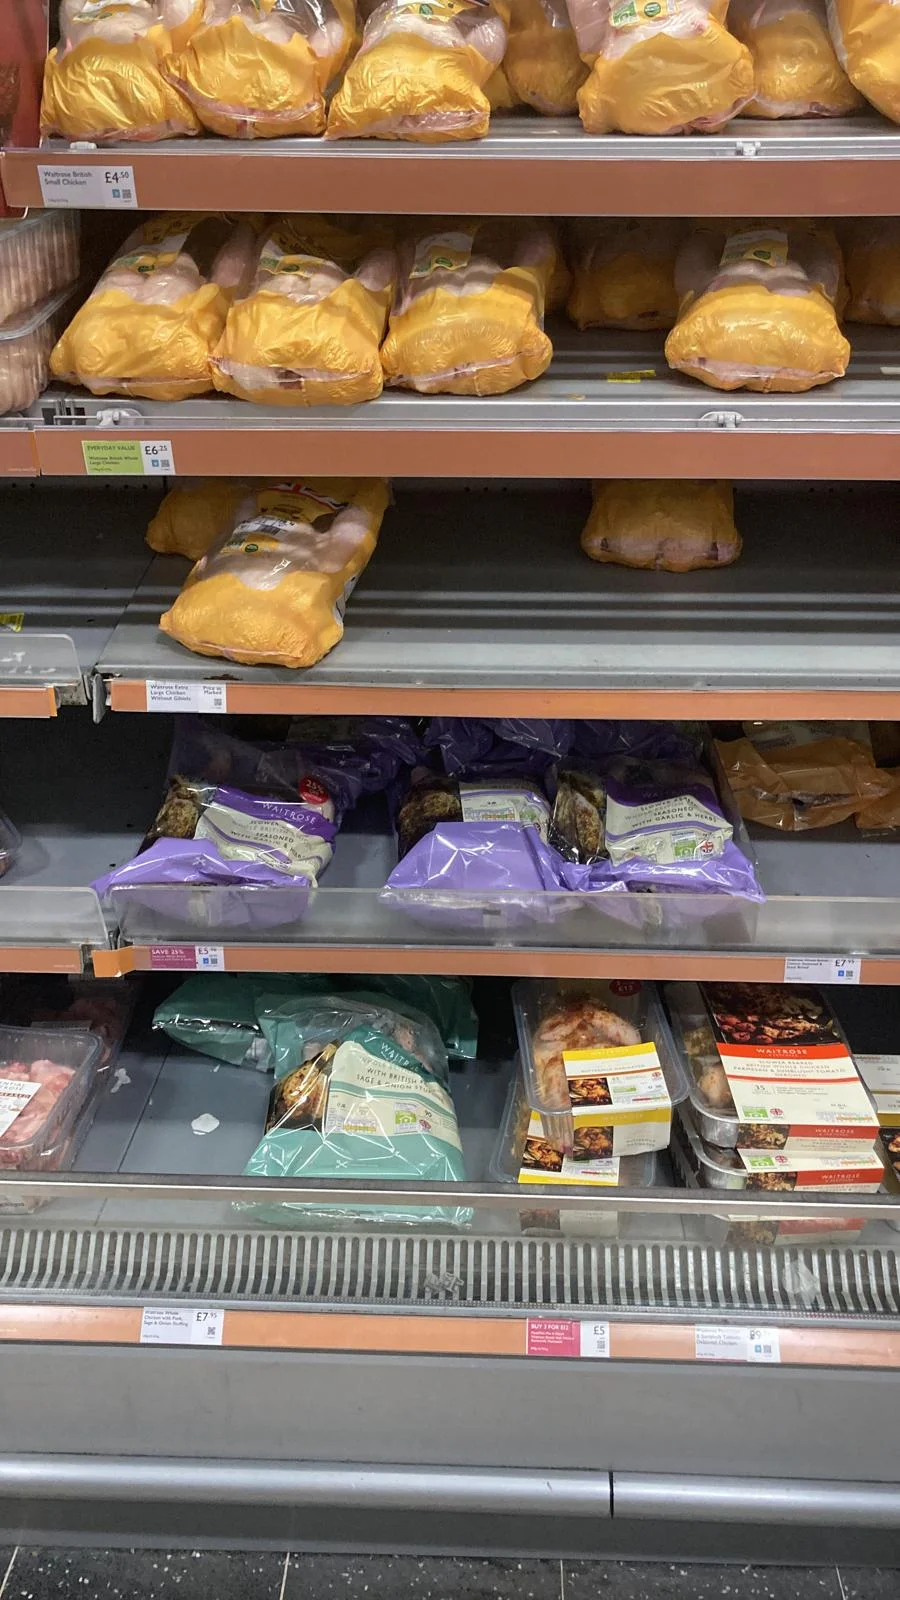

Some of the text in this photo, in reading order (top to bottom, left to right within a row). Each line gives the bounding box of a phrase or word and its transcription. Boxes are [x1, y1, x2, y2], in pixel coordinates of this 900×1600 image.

[262, 802, 317, 825] WAITROSE
[655, 812, 684, 822] GARLIC
[593, 1325, 605, 1336] £5
